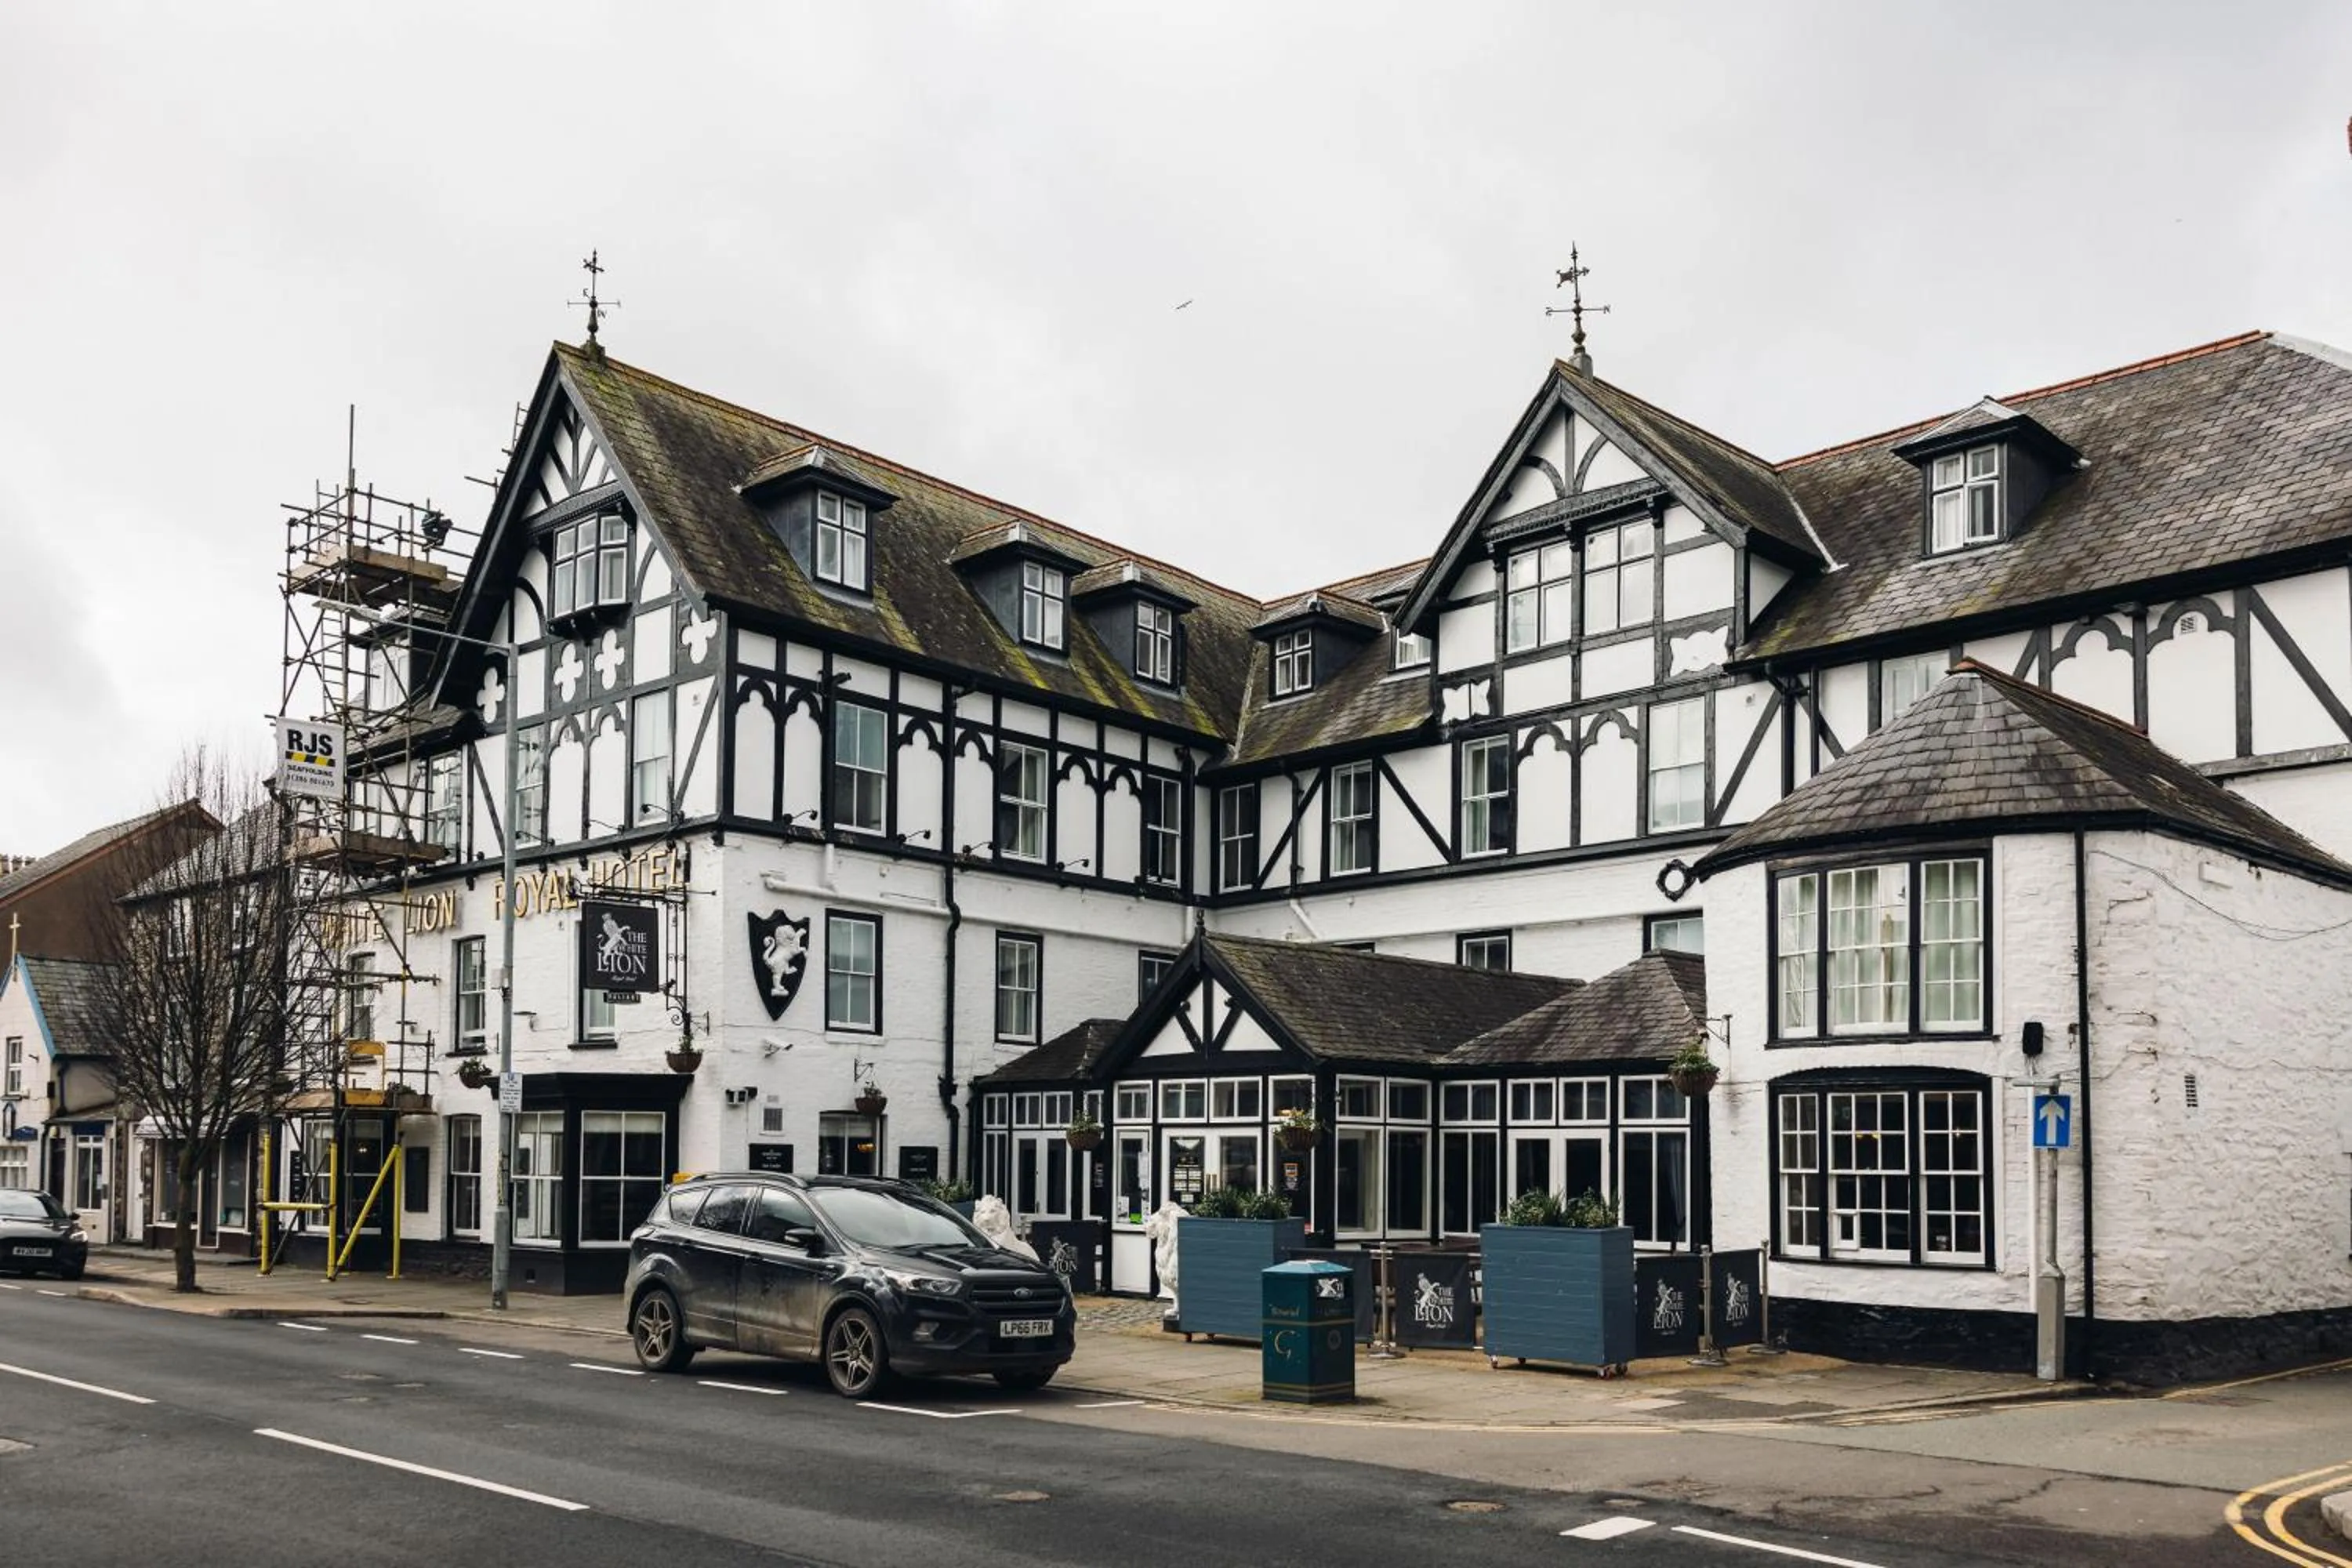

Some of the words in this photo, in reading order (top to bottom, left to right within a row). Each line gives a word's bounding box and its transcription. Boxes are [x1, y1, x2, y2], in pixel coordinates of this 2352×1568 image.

[287, 728, 333, 756] RJS
[405, 890, 456, 935] LION
[591, 847, 689, 896] HOTEL
[626, 931, 647, 943] THE
[597, 952, 647, 974] LION
[1414, 1304, 1454, 1323] LION
[1653, 1310, 1684, 1330] LION
[1004, 1322, 1030, 1335] LP66
[1032, 1321, 1051, 1334] FRX
